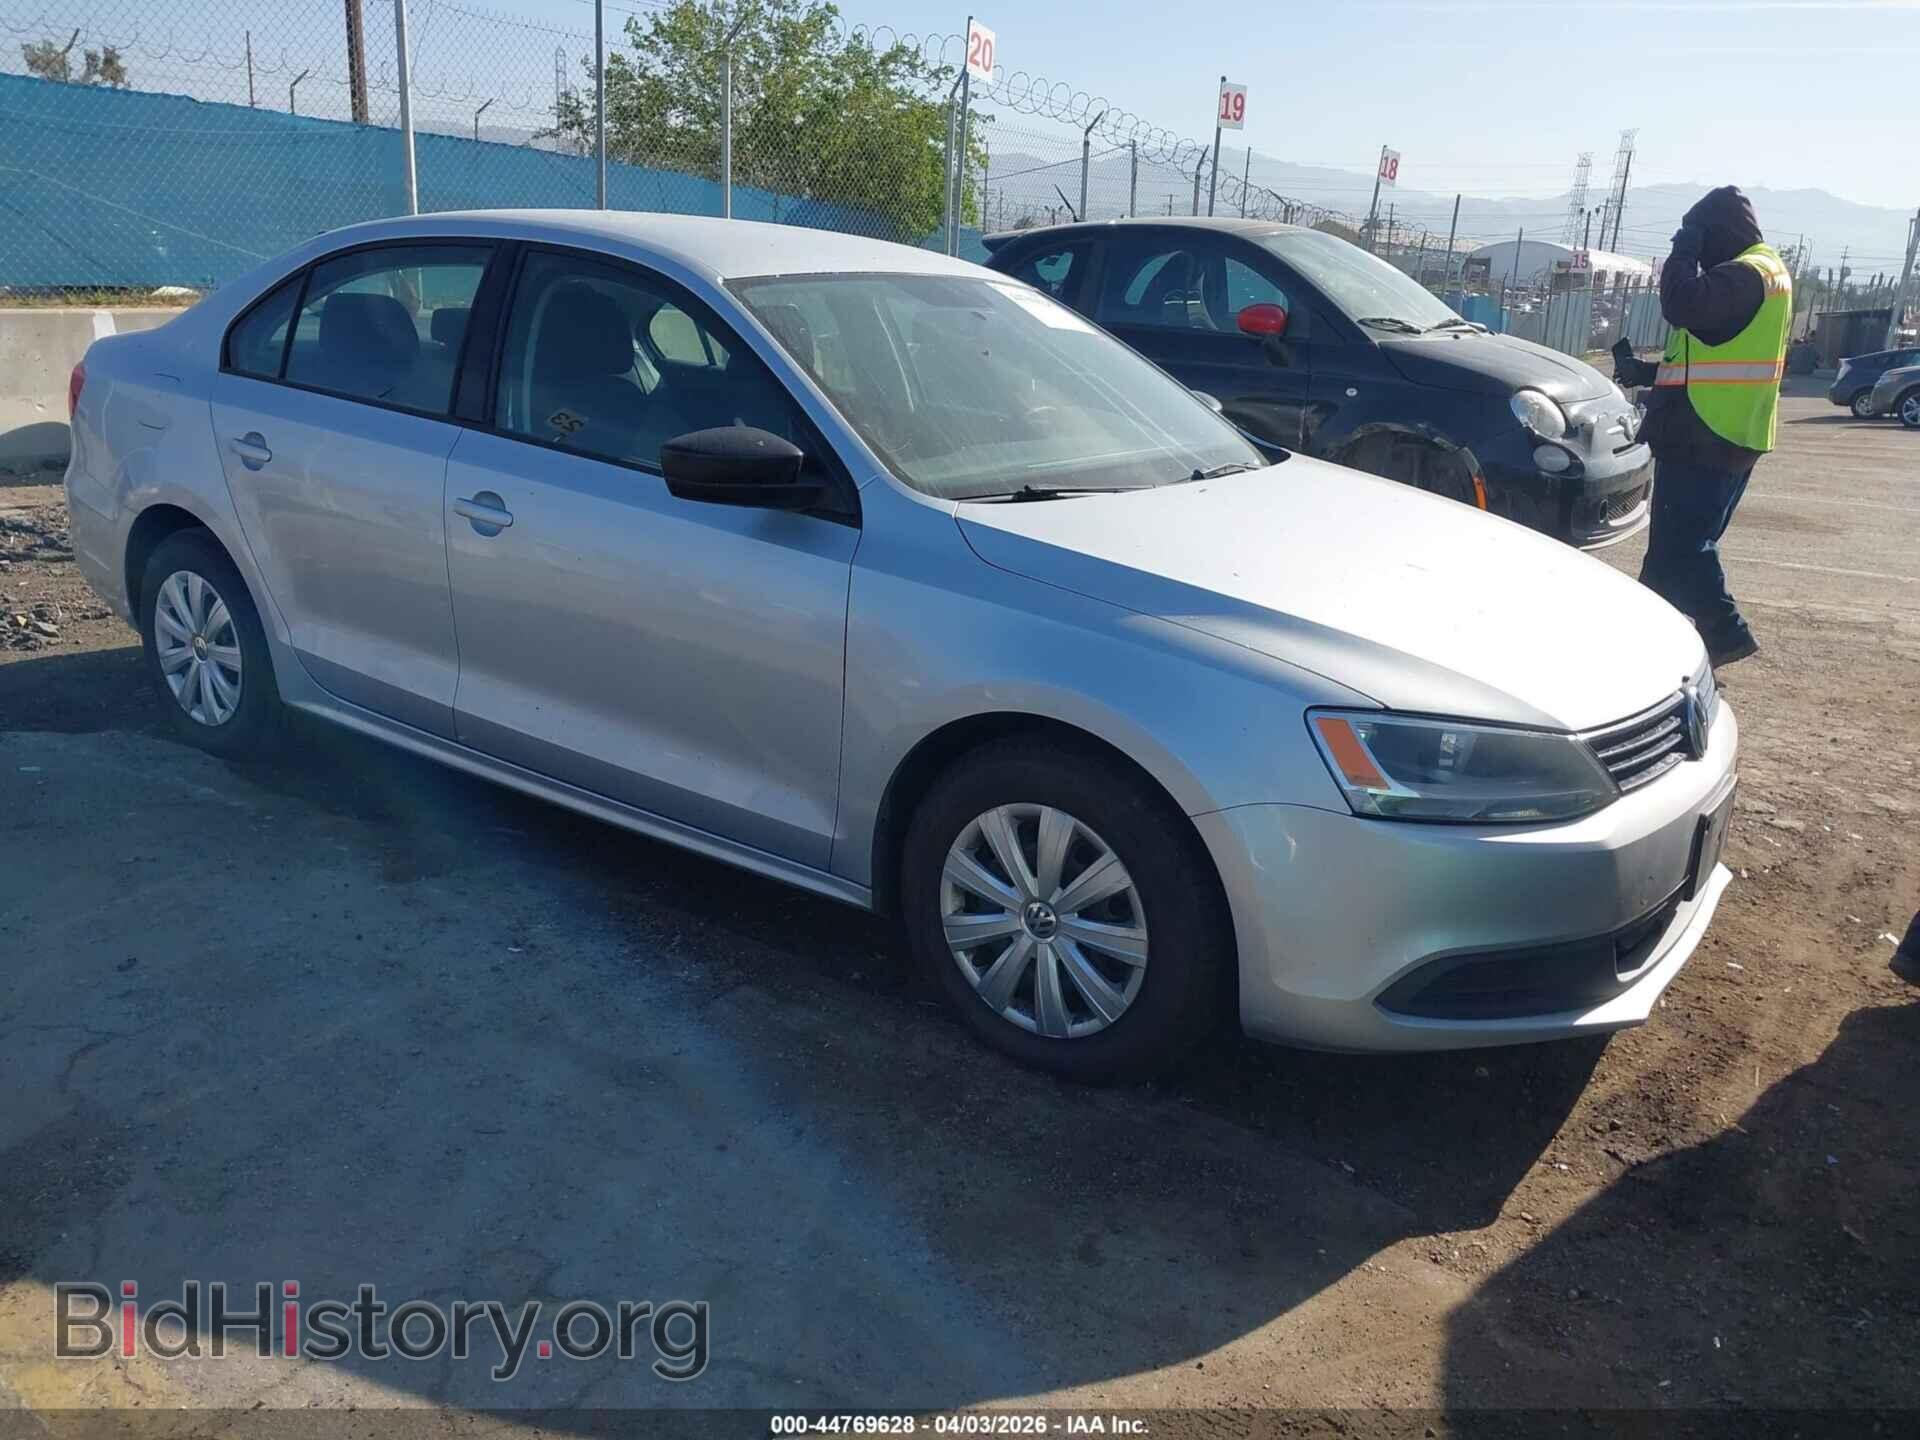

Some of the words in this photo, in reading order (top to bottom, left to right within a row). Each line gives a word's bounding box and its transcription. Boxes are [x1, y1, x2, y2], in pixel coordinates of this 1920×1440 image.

[968, 31, 993, 73] 20
[1220, 91, 1245, 122] 19
[1380, 156, 1399, 181] 18
[1572, 253, 1589, 269] 15
